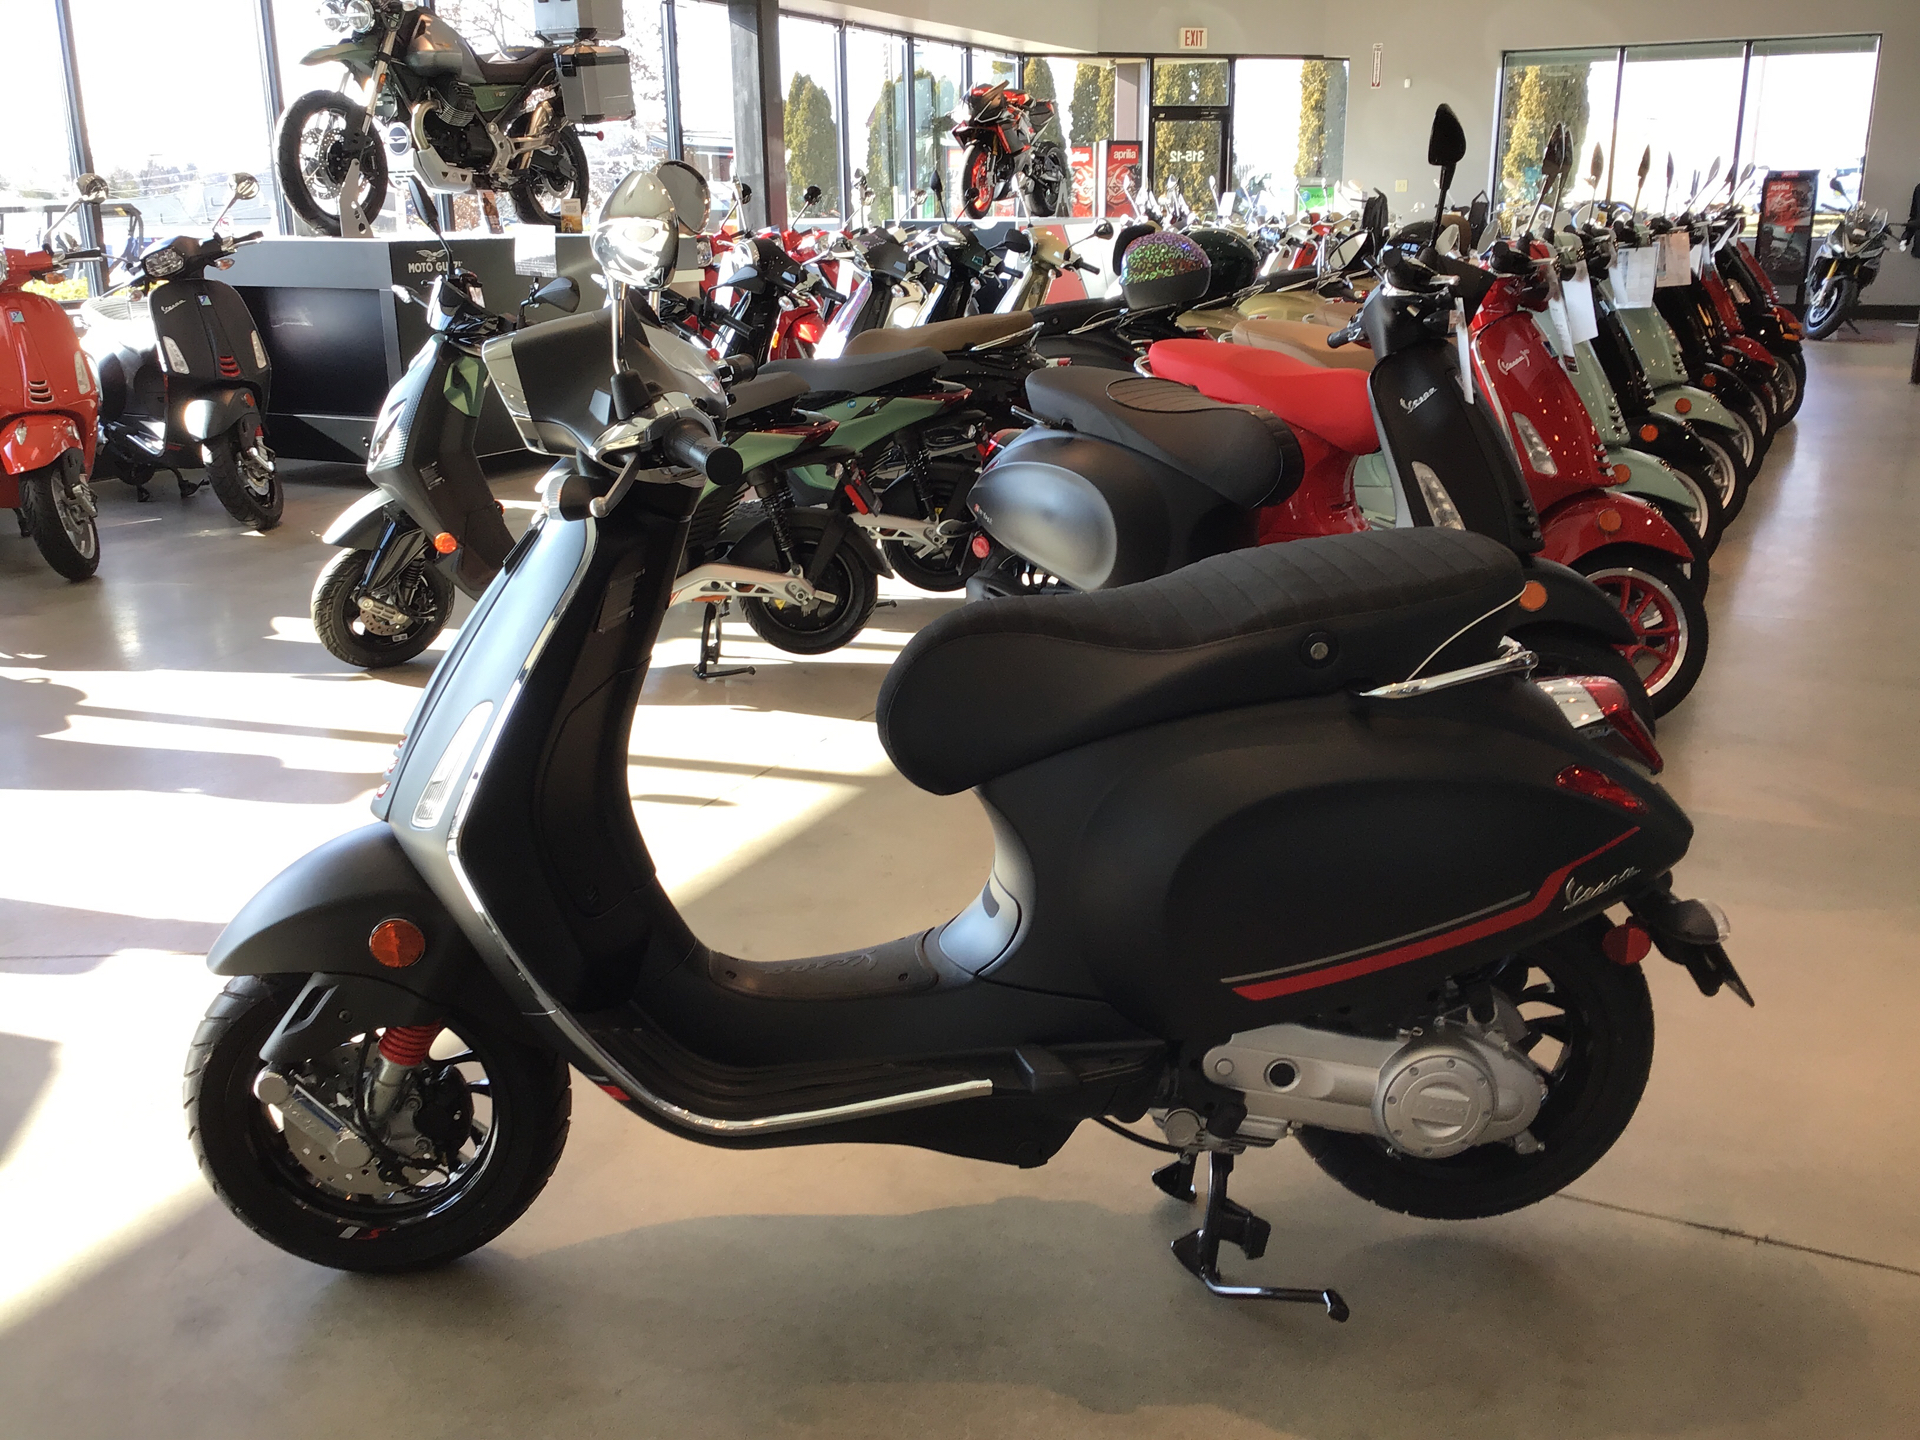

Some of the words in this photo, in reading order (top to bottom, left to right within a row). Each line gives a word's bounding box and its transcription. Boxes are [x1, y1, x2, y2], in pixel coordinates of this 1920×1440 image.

[1184, 30, 1204, 46] EXIT
[1113, 148, 1136, 160] aprilia
[408, 262, 433, 273] MOTO
[1399, 387, 1438, 415] Vespa
[1562, 866, 1642, 912] Vespa
